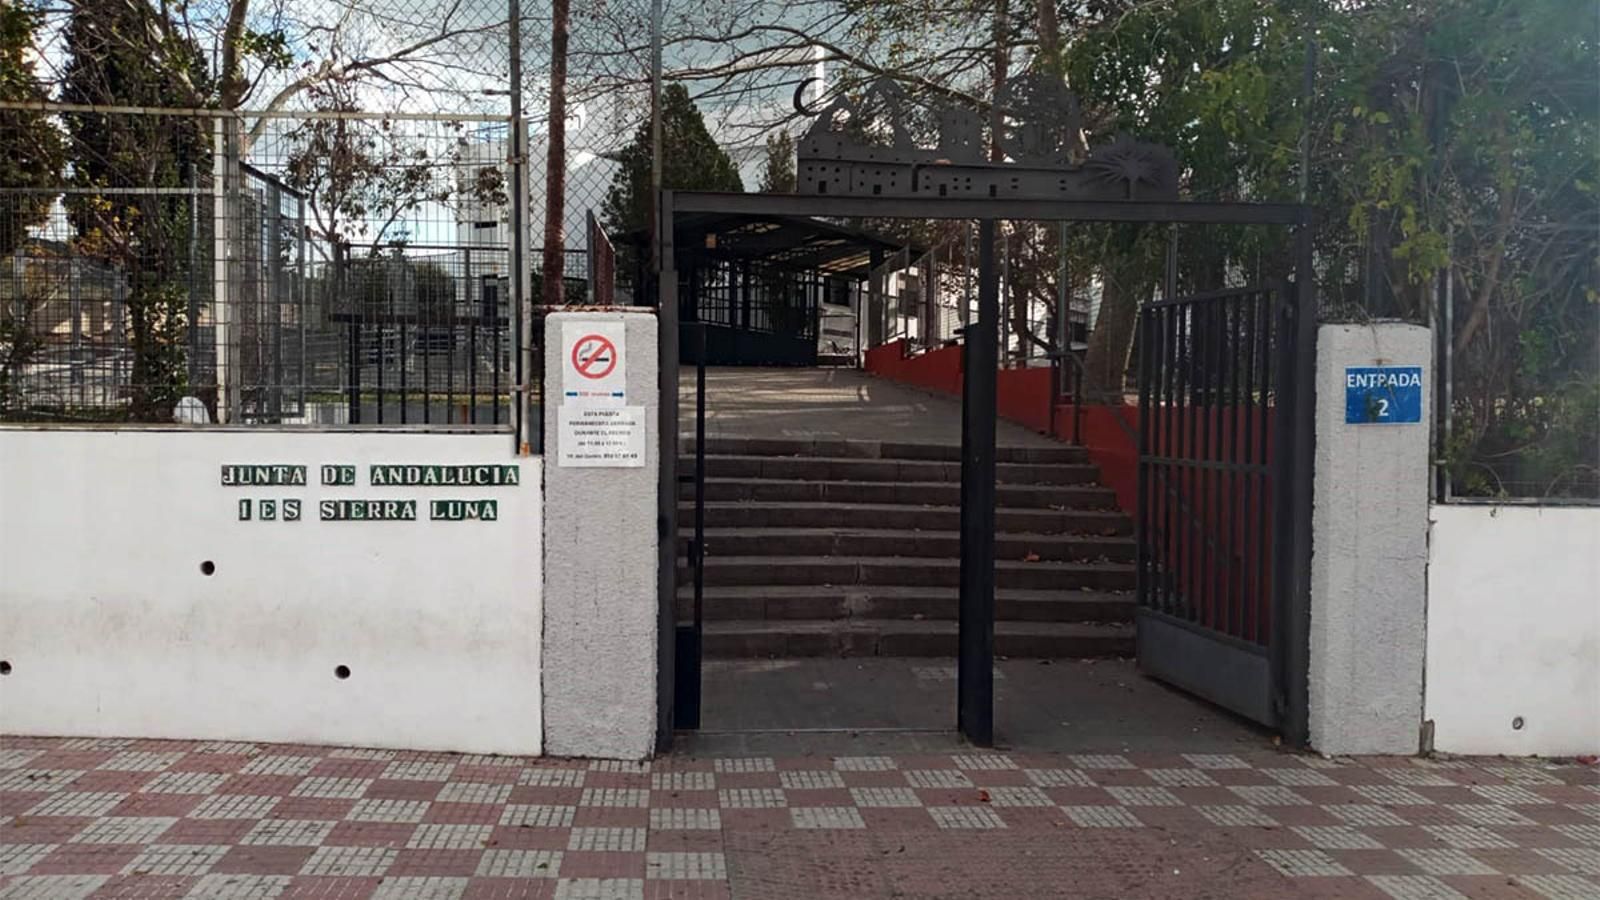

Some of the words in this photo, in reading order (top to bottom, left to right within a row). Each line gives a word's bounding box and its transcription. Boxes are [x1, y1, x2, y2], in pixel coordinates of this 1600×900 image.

[1347, 373, 1421, 388] ENTRADA
[1377, 399, 1389, 417] 2
[222, 466, 305, 484] JUNTA
[322, 466, 355, 484] DE
[371, 466, 519, 484] ANDALUCIA
[320, 501, 416, 519] SIERRA
[431, 501, 497, 519] LUNA
